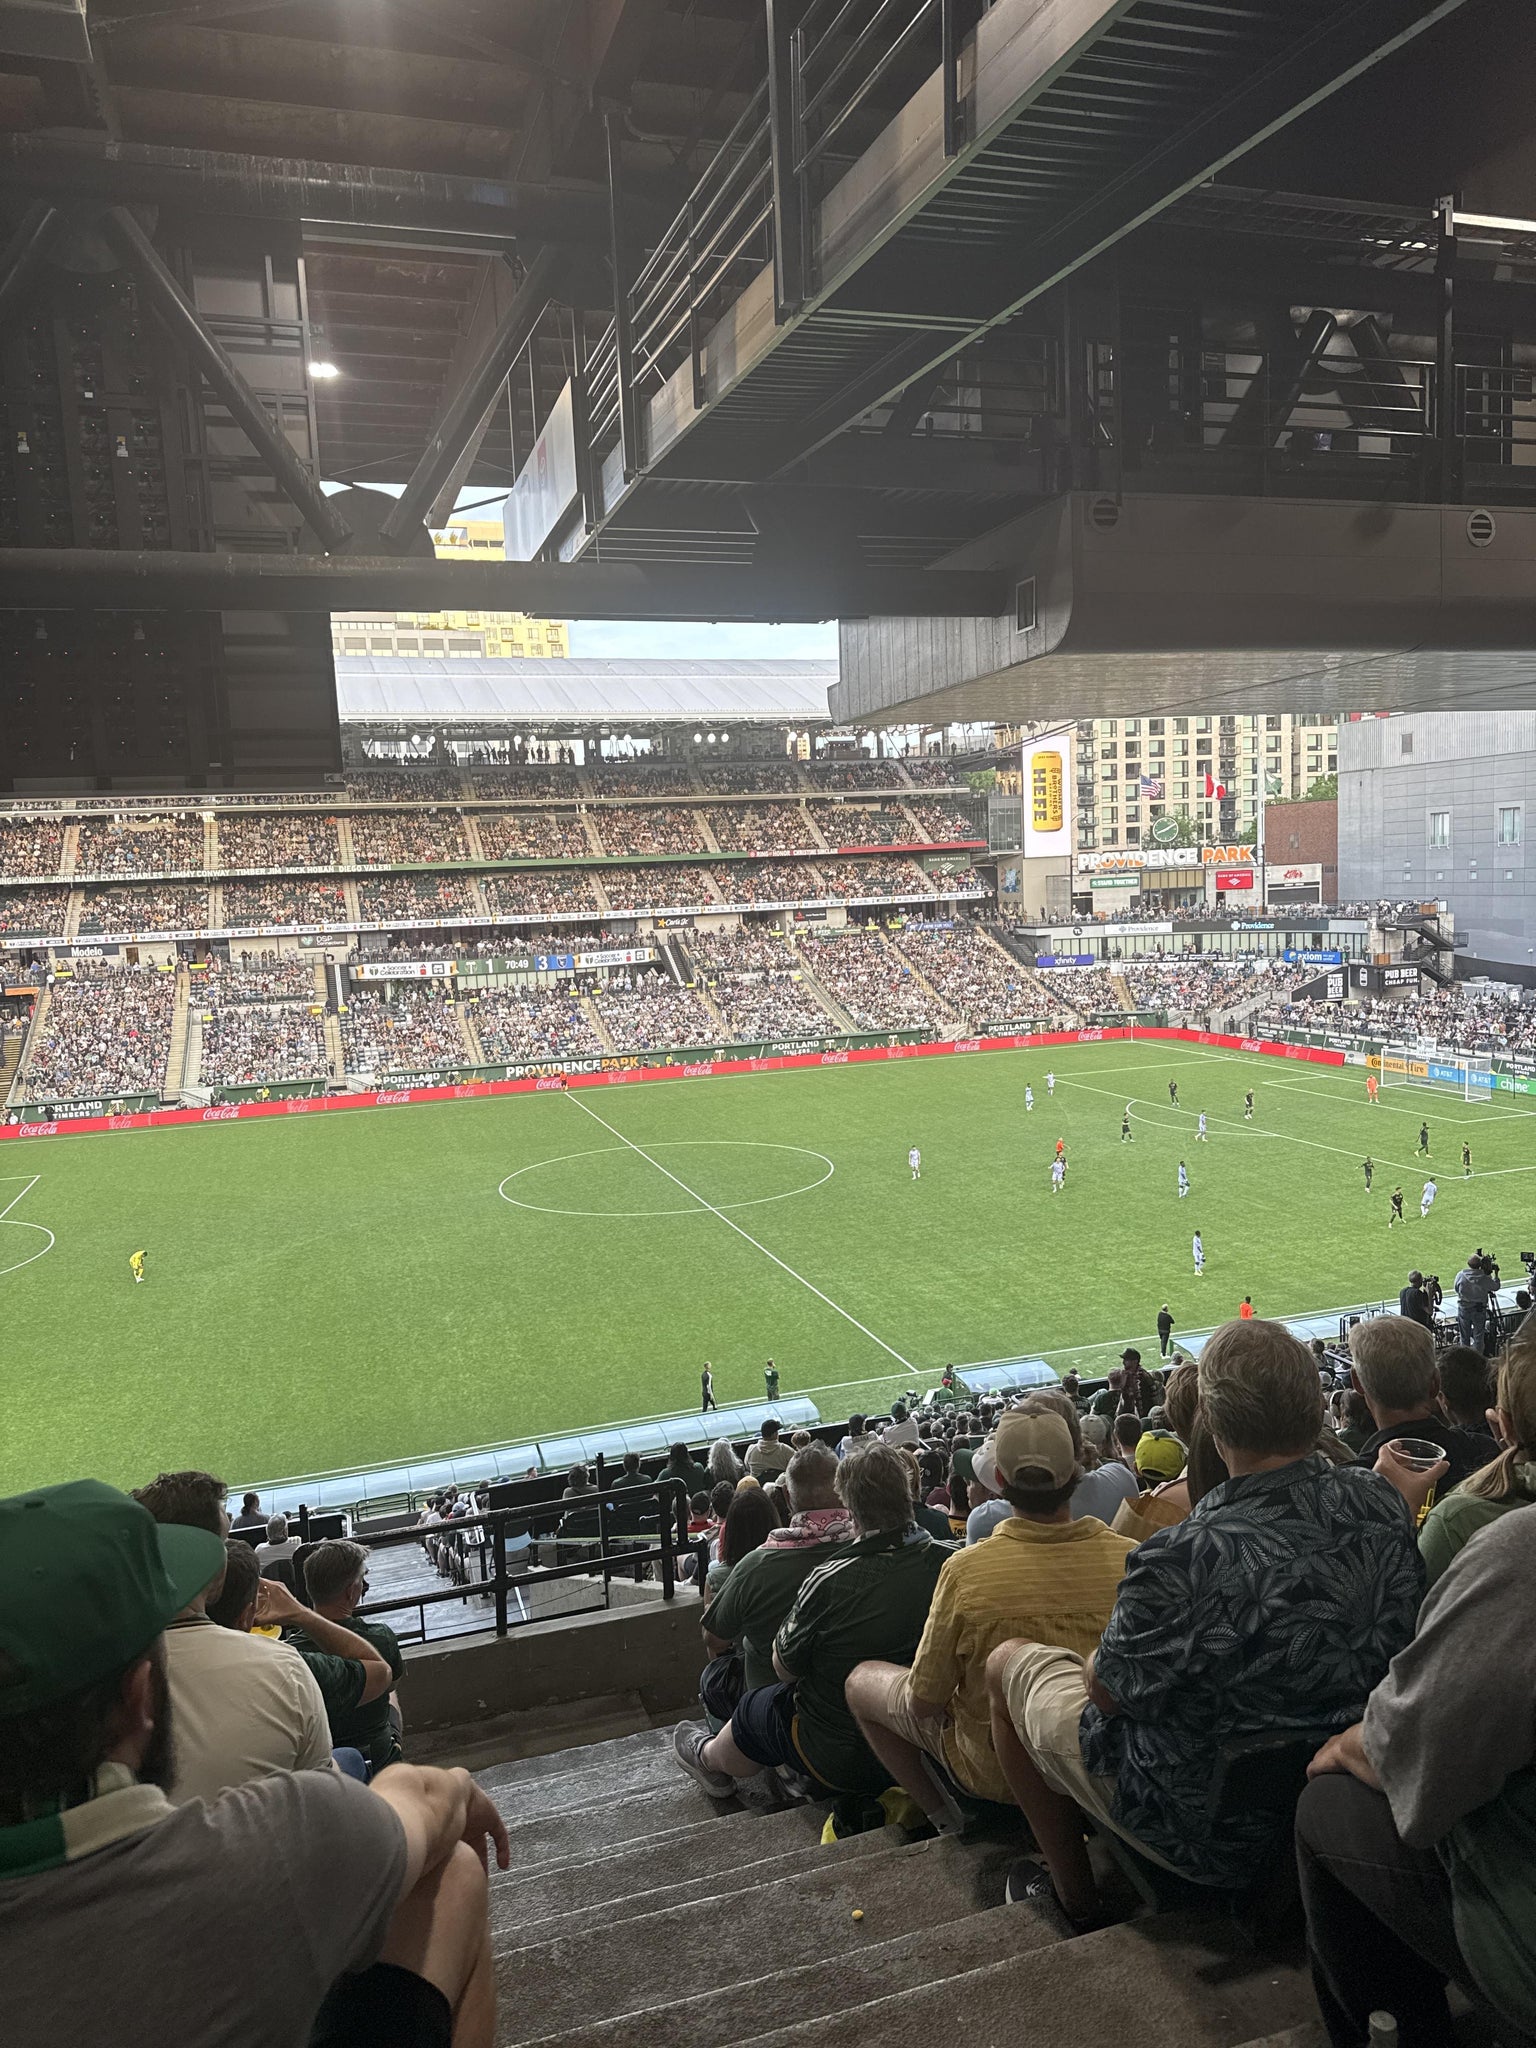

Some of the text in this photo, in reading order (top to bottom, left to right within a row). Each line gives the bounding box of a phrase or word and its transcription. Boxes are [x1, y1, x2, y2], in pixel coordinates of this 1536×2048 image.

[1033, 768, 1047, 821] HEFE
[1078, 846, 1254, 870] PROVIDENCE PARK
[235, 868, 266, 876] TIMBER
[307, 866, 334, 874] HOBAN
[364, 864, 392, 872] VALERI
[126, 872, 164, 880] CHARLES
[170, 870, 230, 878] JIMMY CONWAY
[1241, 922, 1274, 930] Providence
[71, 947, 103, 958] Modelo
[1298, 952, 1322, 961] axiom
[486, 956, 549, 974] 1 70:49 3
[1054, 956, 1078, 965] xfinity
[1385, 968, 1418, 979] PUB BEER
[1327, 978, 1344, 987] PUB
[1327, 986, 1344, 994] BEER
[988, 1022, 1031, 1032] PORTLAND
[772, 1040, 820, 1050] PORTLAND
[506, 1056, 640, 1078] PROVIDENCE PARK
[1372, 1057, 1404, 1071] Coninental
[1506, 1062, 1536, 1072] PORTLAND
[1500, 1078, 1528, 1092] chime
